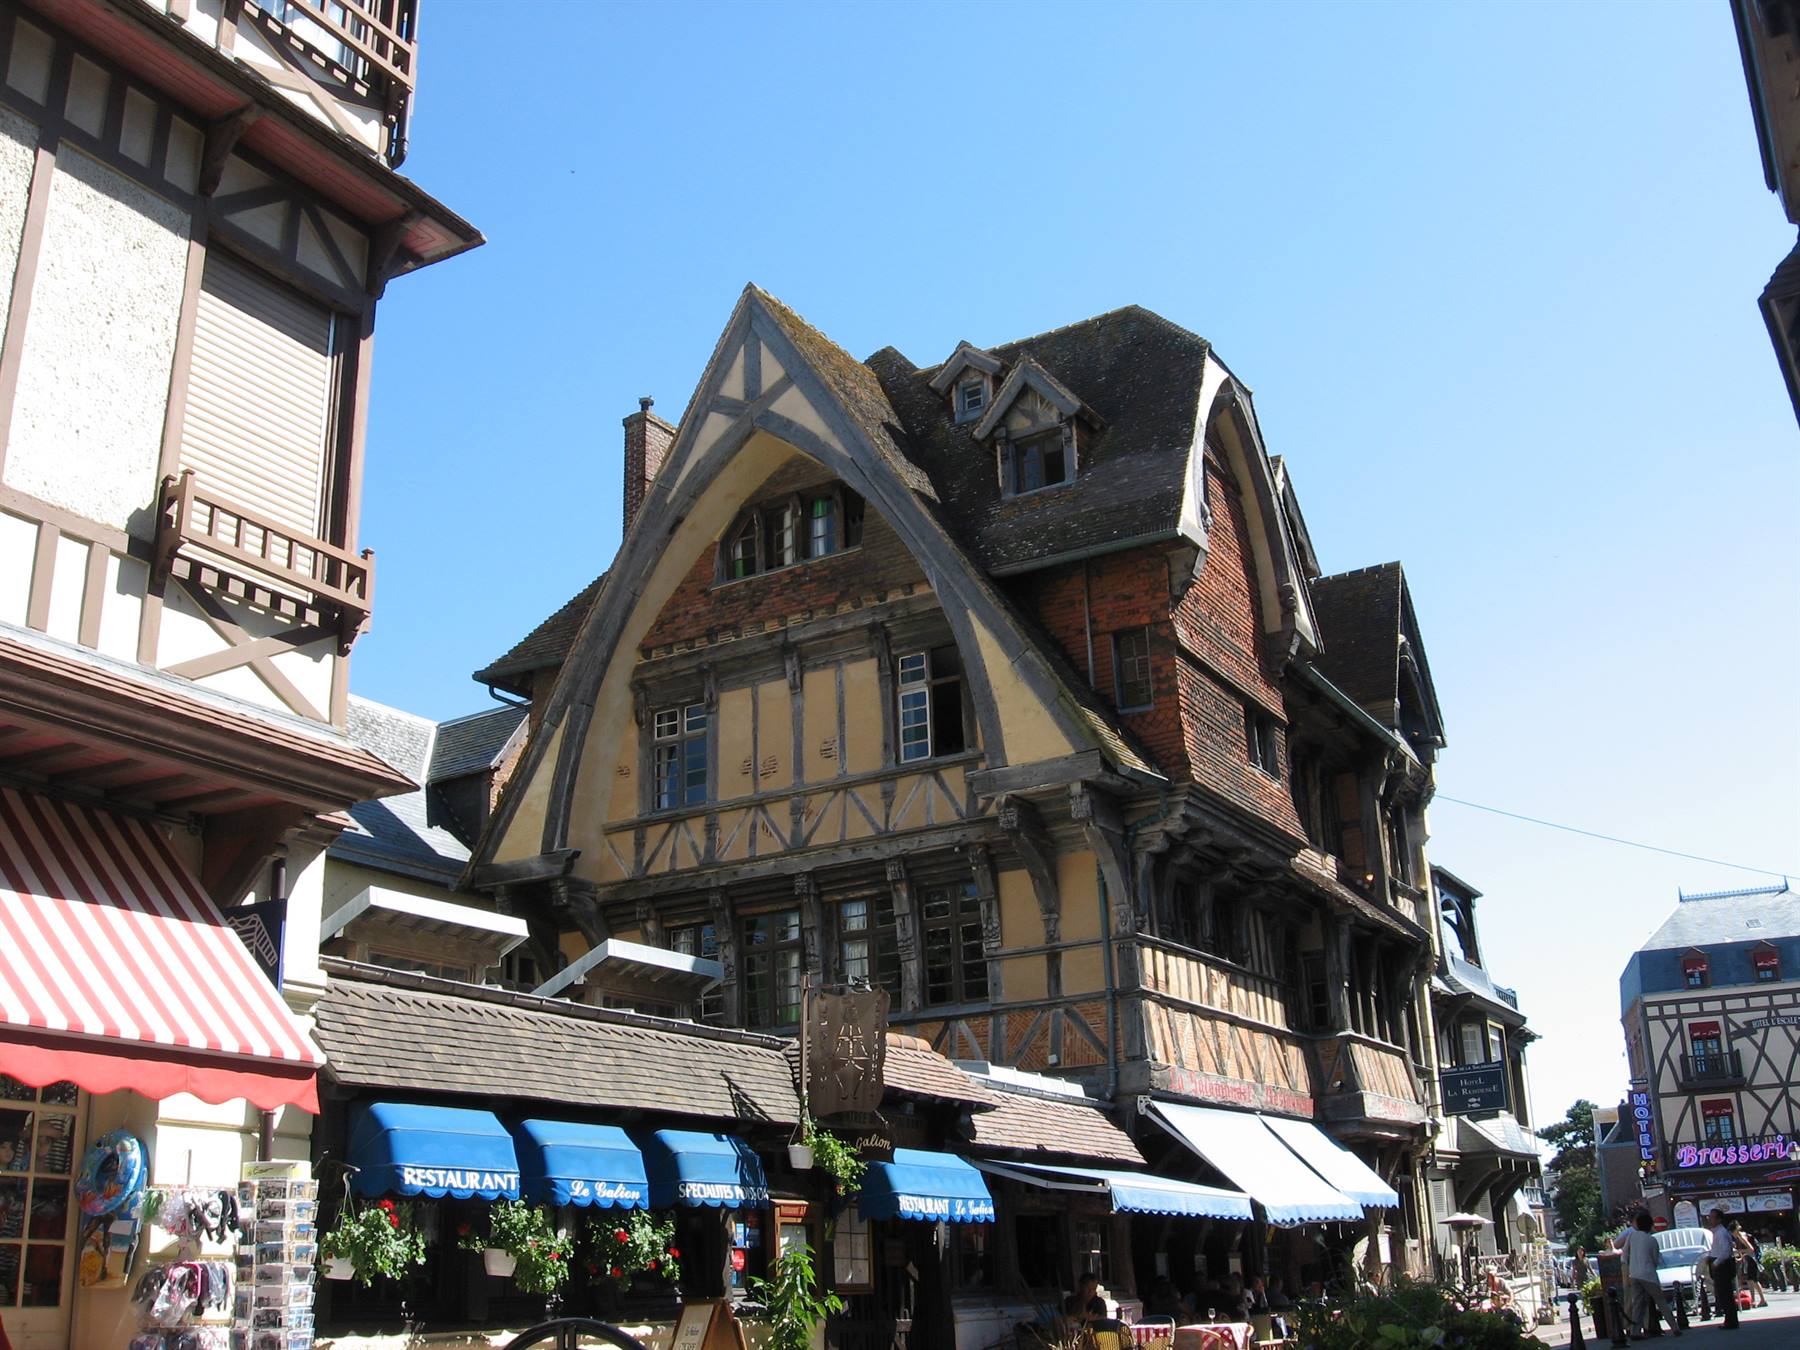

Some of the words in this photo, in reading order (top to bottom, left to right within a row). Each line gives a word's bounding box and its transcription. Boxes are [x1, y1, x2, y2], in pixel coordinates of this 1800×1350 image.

[1633, 1093, 1653, 1160] HOTEL
[403, 1167, 519, 1190] RESTAURANT
[569, 1179, 590, 1198] Le
[594, 1181, 641, 1200] Galion
[898, 1194, 949, 1214] RESTAURANT
